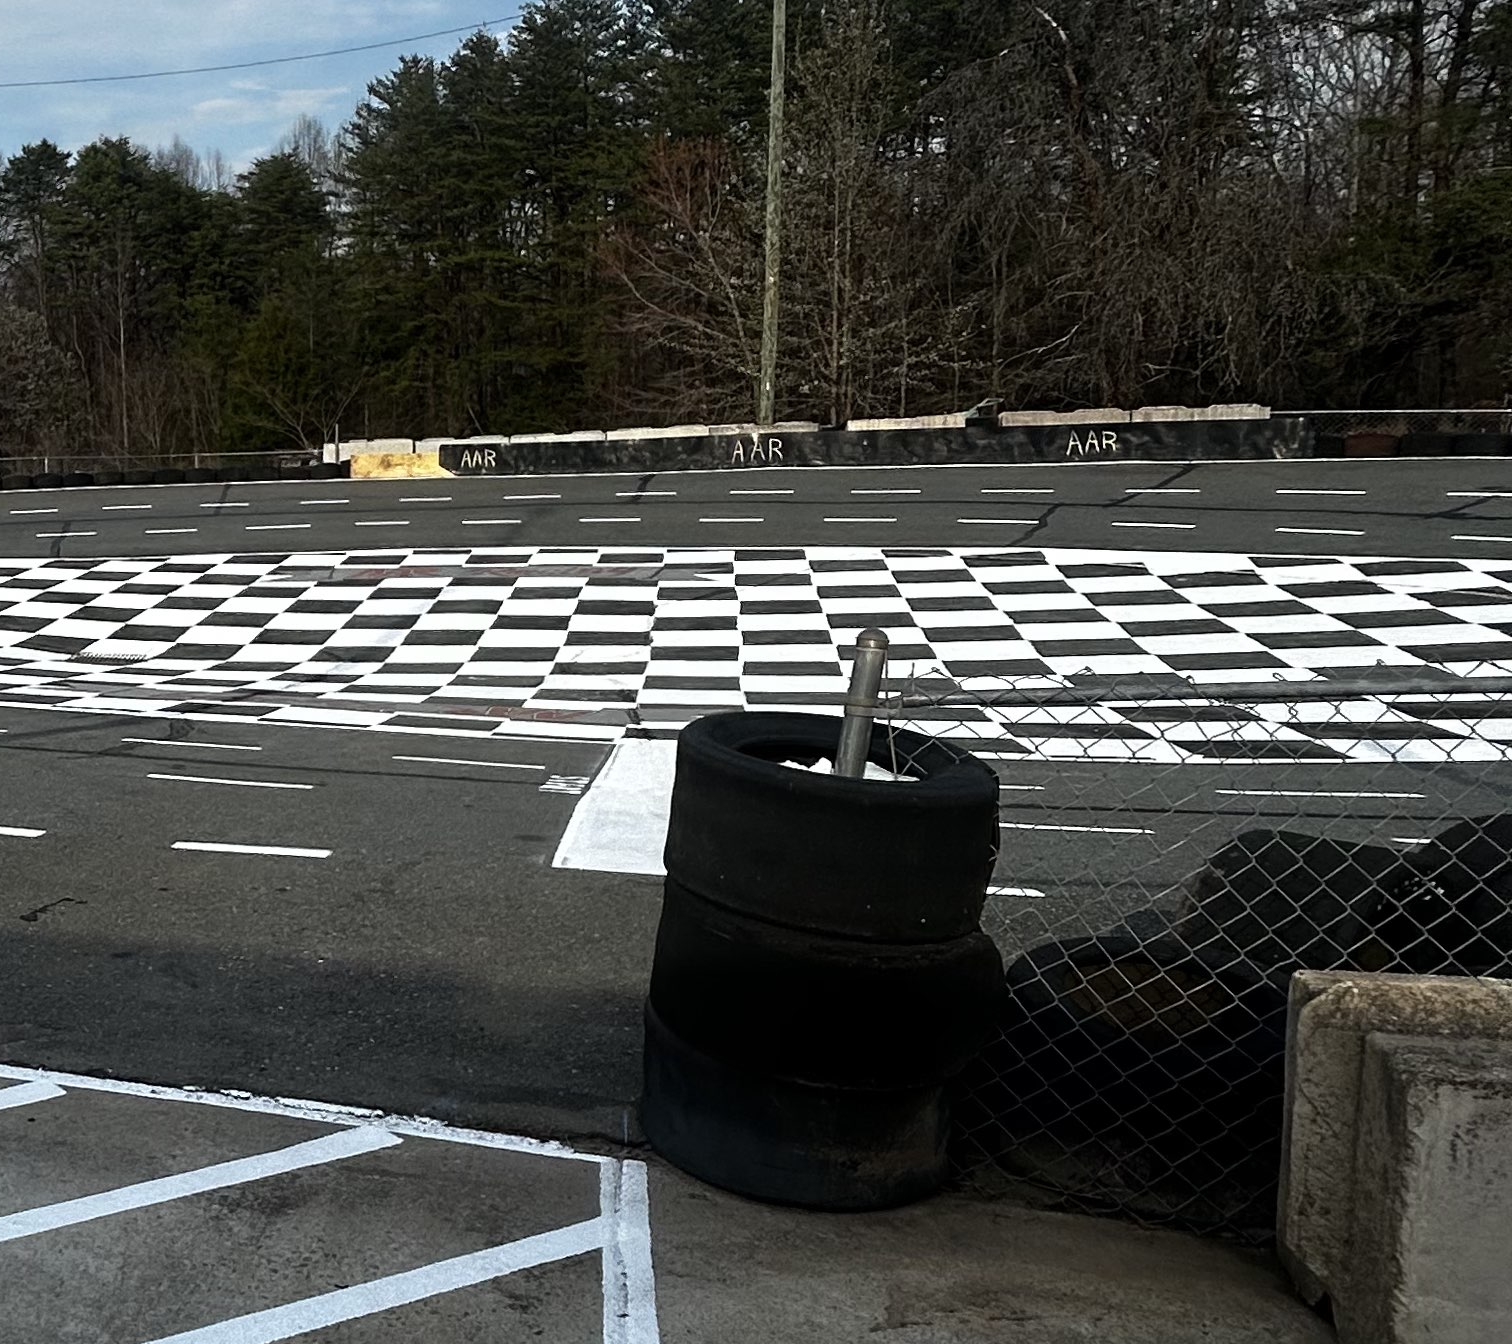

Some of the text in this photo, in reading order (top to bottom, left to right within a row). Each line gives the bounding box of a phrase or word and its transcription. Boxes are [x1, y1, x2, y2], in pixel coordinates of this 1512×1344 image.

[731, 437, 784, 464] AAR
[1066, 430, 1117, 456] AAR
[460, 448, 496, 468] AAR
